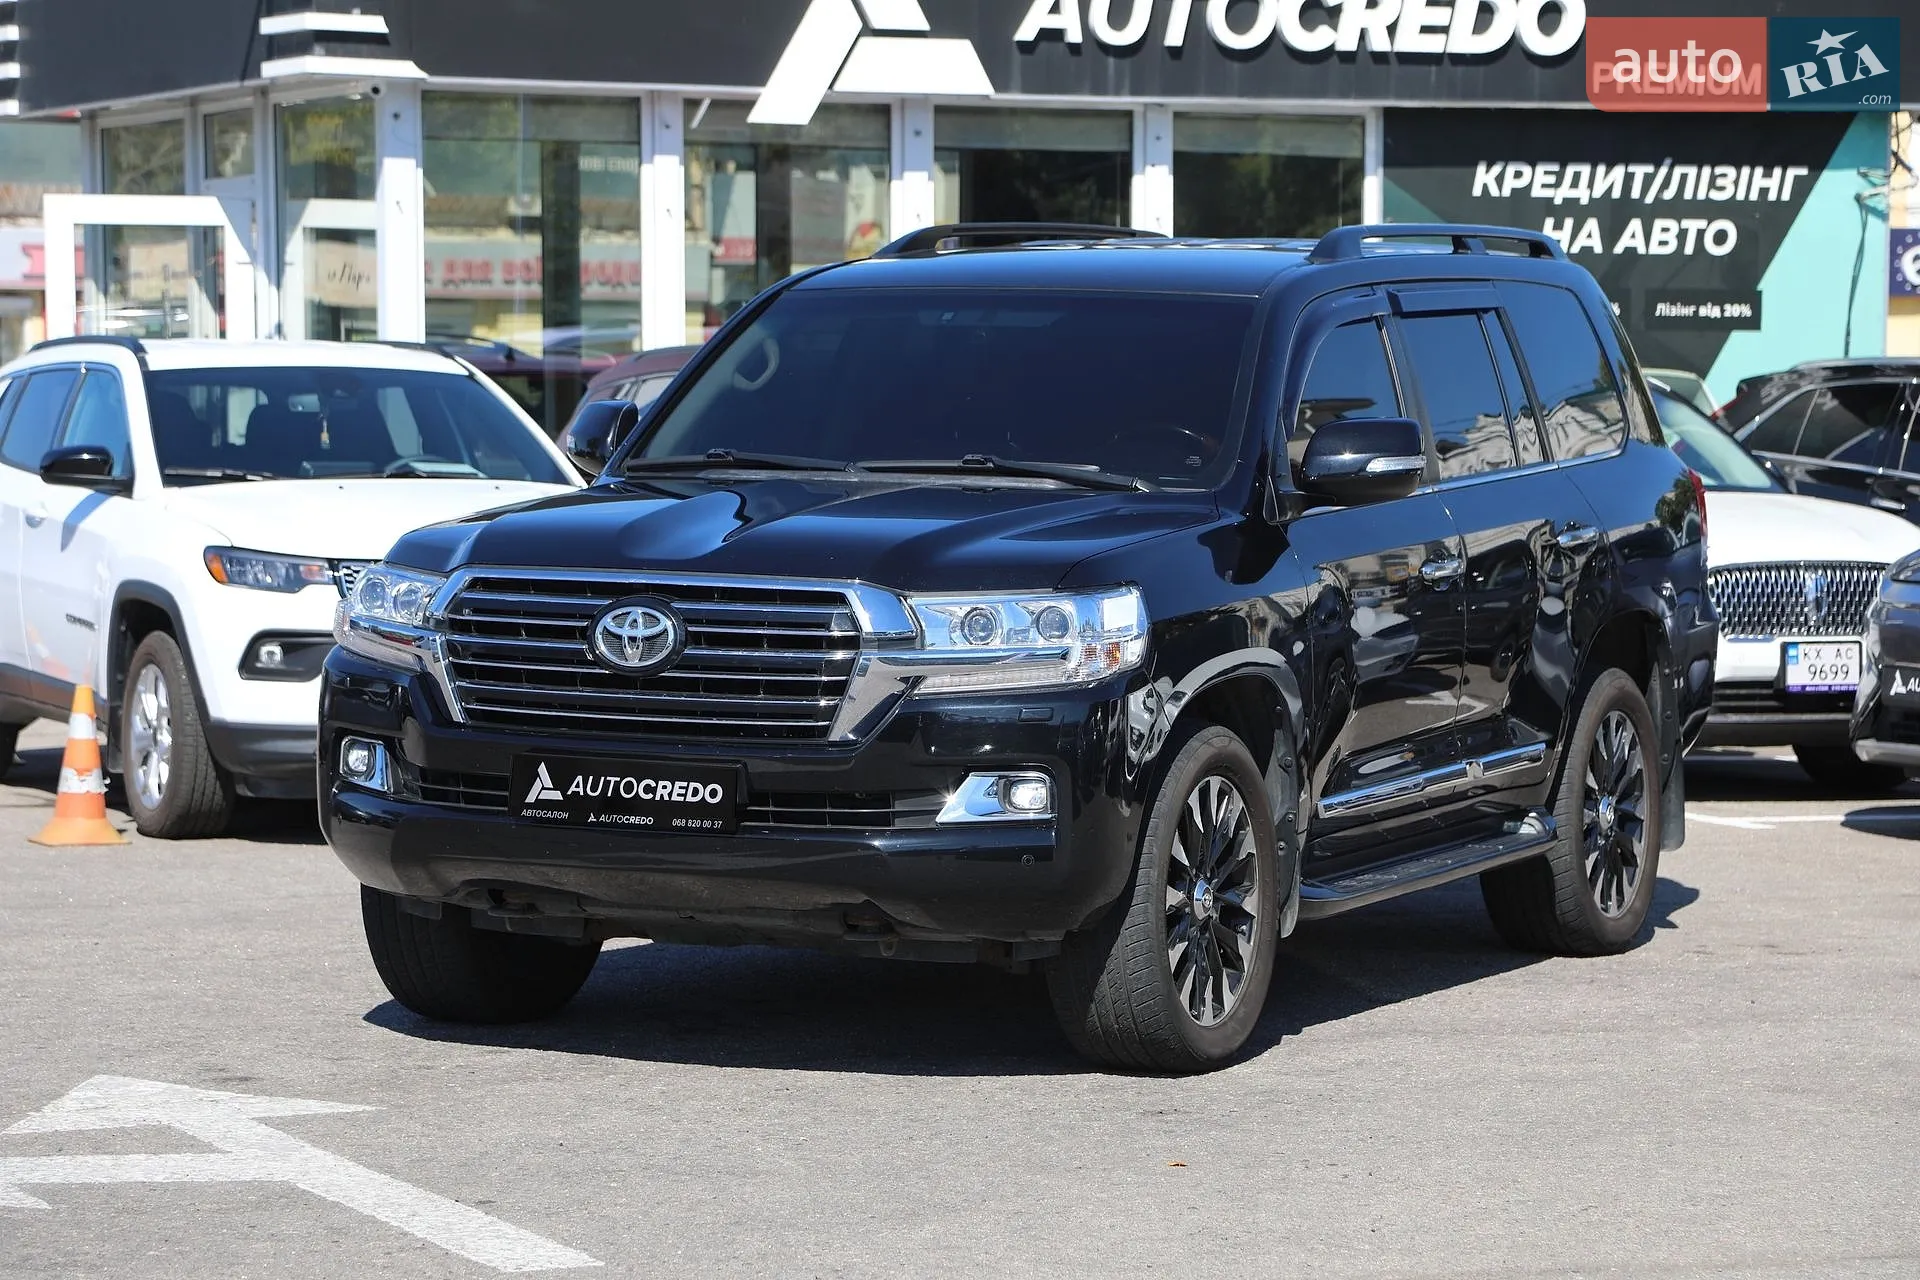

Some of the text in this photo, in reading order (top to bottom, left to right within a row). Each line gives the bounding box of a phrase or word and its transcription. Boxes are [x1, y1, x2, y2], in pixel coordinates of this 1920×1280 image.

[1013, 0, 1586, 57] AUTOCREDO
[1472, 158, 1808, 204] КРЕДИТ/ЛІЗІНГ
[1542, 217, 1738, 256] НА АВТО
[1655, 302, 1752, 318] Лізінг від 20%
[1808, 664, 1849, 681] 9699
[567, 776, 723, 803] AUTOCREDO
[521, 808, 569, 820] АВТОСАЛОН
[599, 814, 654, 825] AUTOCREDO
[672, 818, 723, 828] 068 820 00 37
